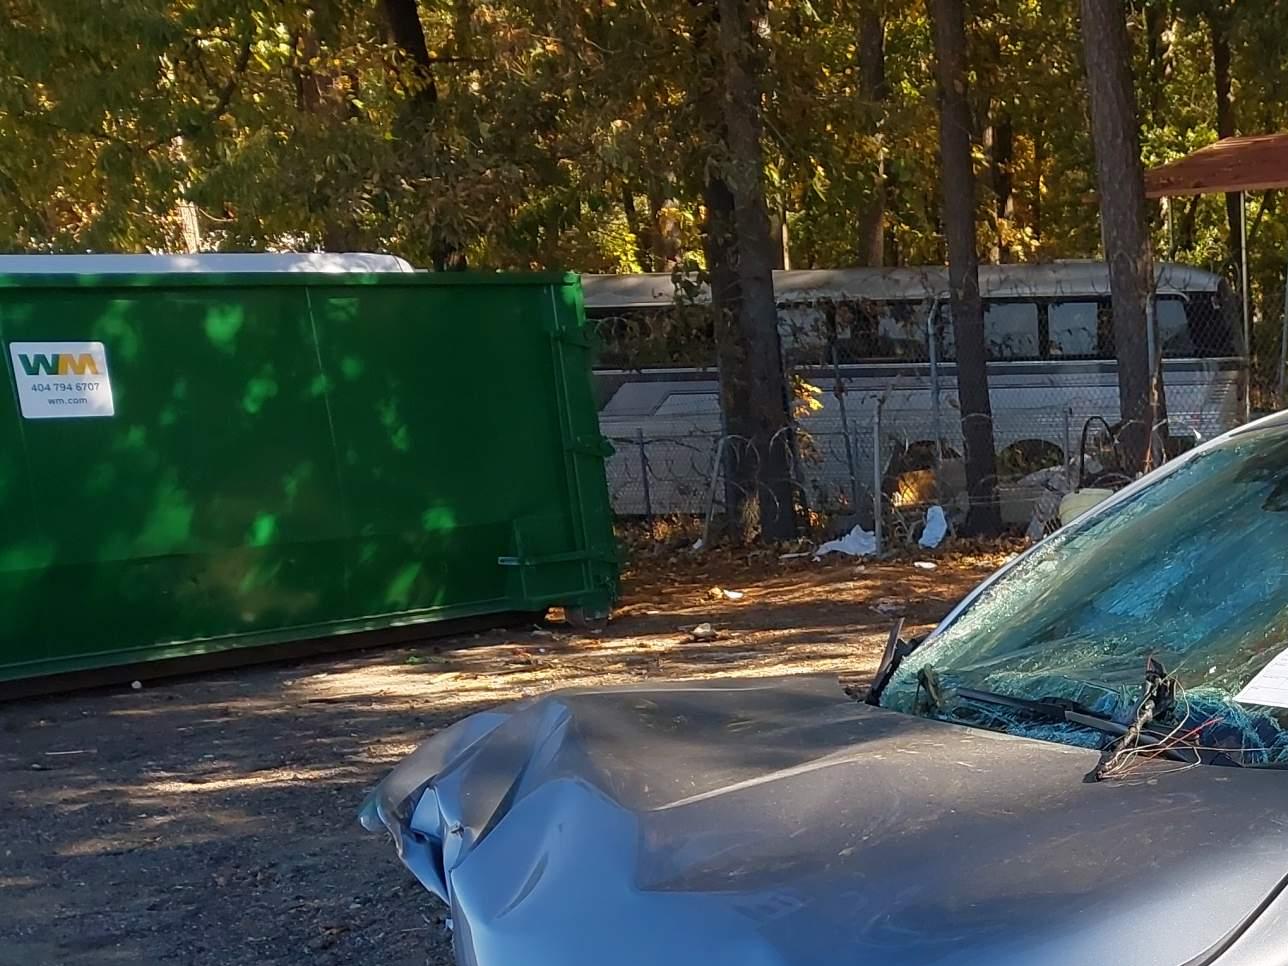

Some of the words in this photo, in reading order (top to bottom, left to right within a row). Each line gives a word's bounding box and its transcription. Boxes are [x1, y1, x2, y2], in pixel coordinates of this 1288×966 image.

[18, 353, 100, 376] WM
[31, 383, 51, 392] 404
[53, 383, 73, 392] 794
[76, 382, 100, 392] 6707
[48, 397, 88, 405] wm.com
